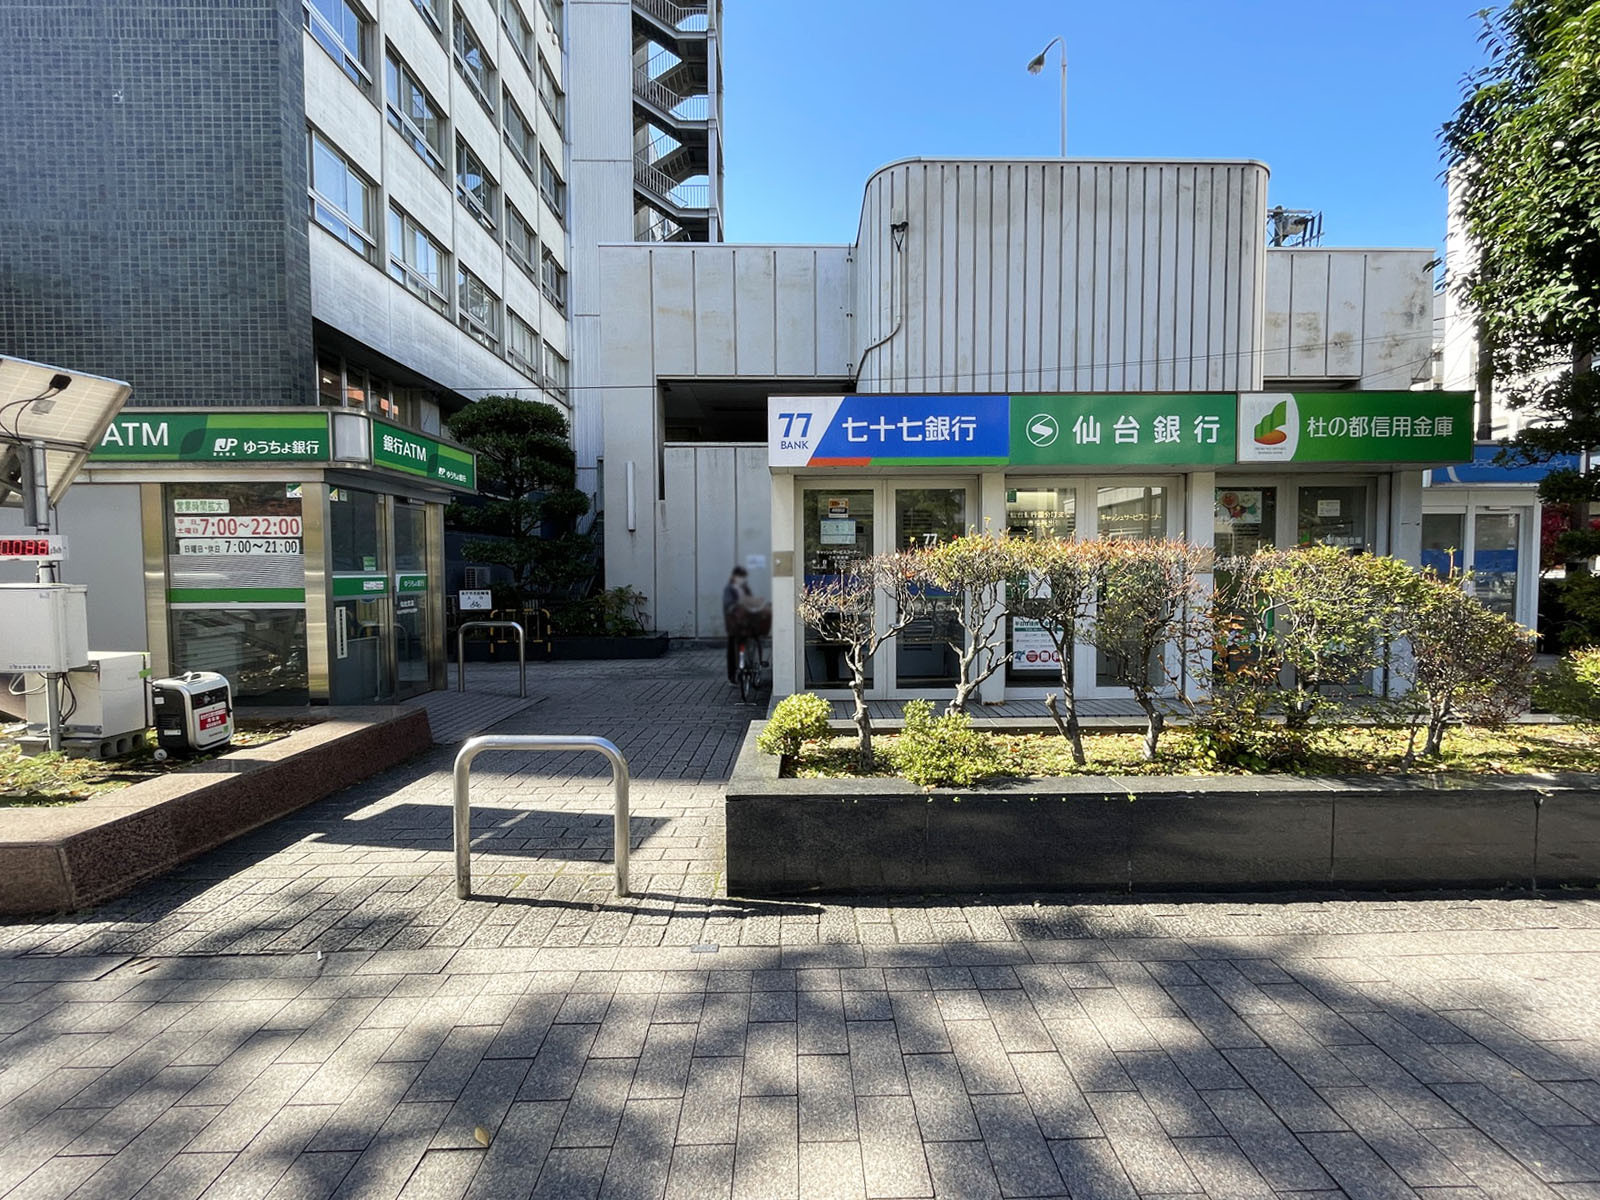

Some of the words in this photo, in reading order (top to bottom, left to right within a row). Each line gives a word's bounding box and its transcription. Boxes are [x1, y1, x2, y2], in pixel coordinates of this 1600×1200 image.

[101, 422, 169, 446] ATM
[778, 413, 813, 438] 77
[842, 415, 977, 442] 七十七銀行
[1072, 415, 1220, 444] 仙台銀行
[1307, 416, 1454, 438] 杜の都信用金庫
[243, 440, 319, 455] ゆうちょ銀行
[383, 434, 427, 462] 銀行ATM
[780, 440, 809, 450] BANK
[923, 533, 938, 545] 77
